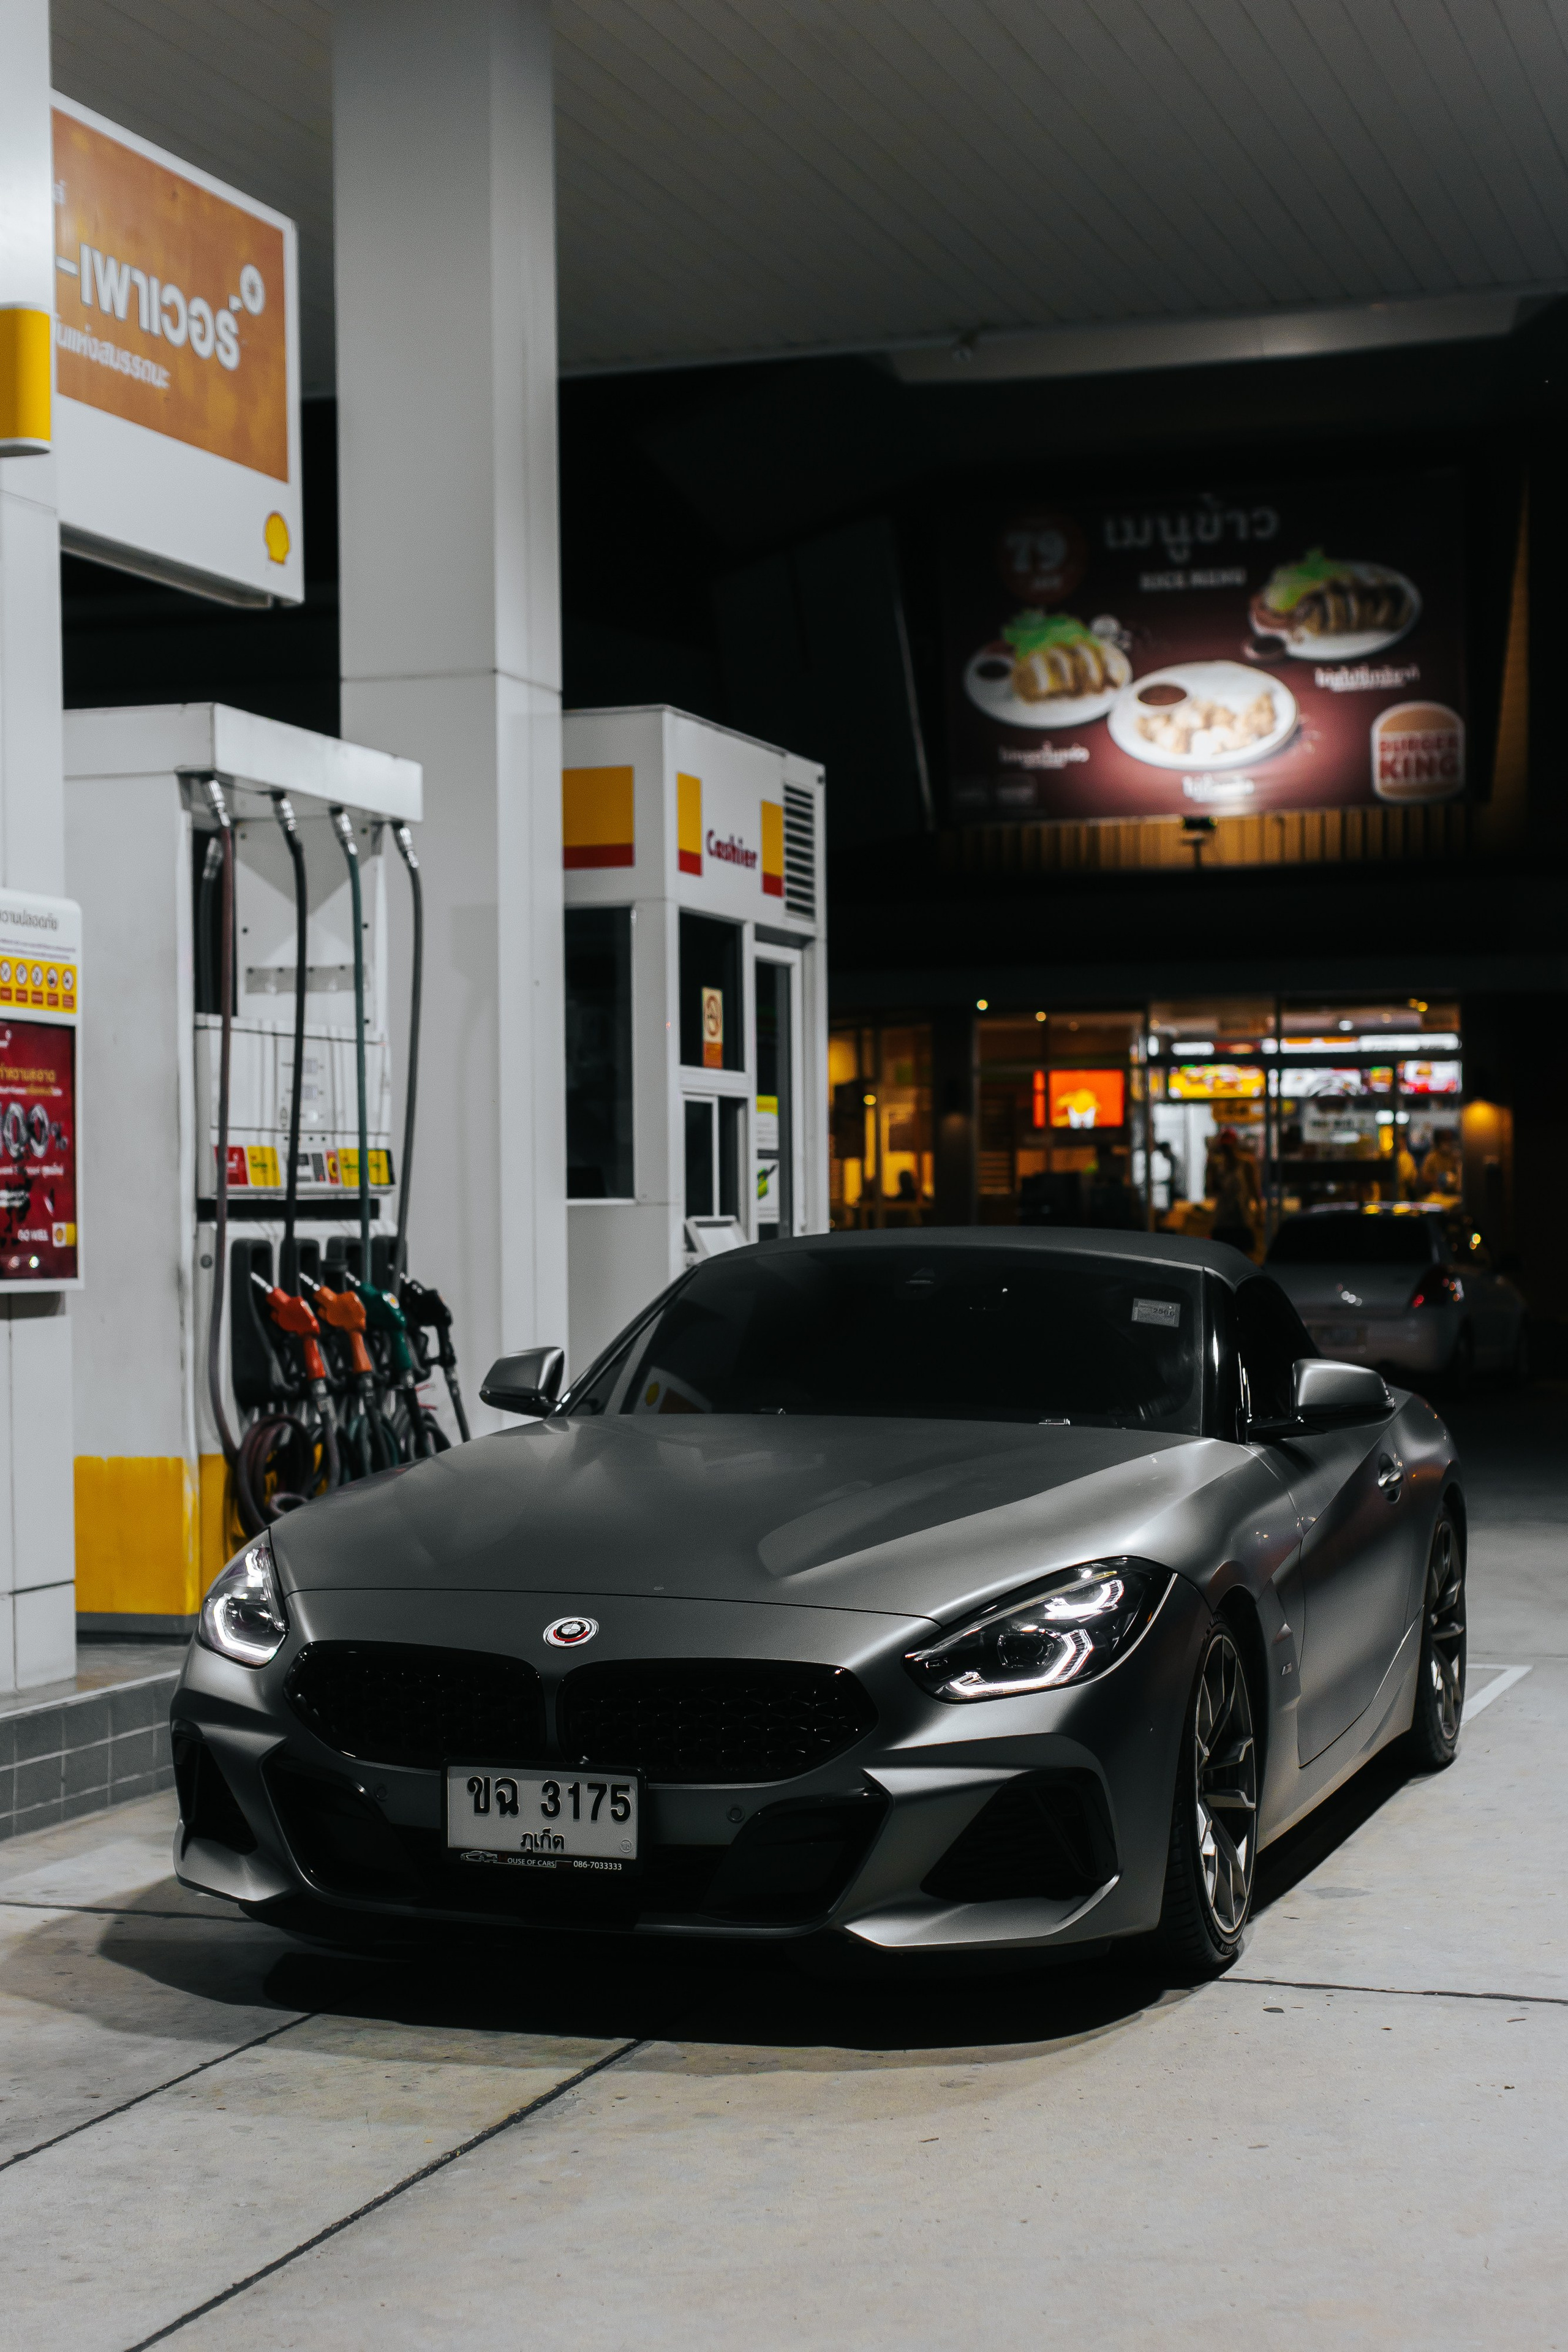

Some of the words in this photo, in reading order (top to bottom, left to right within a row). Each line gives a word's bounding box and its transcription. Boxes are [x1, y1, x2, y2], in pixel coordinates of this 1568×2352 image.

[1006, 529, 1067, 573] 79
[1380, 755, 1458, 778] KING
[707, 829, 757, 869] Cashier
[467, 1776, 519, 1815] ขฉ
[541, 1779, 631, 1822] 3175
[521, 1827, 565, 1852] ภูเก็ต
[573, 1860, 622, 1871] 086-7033333
